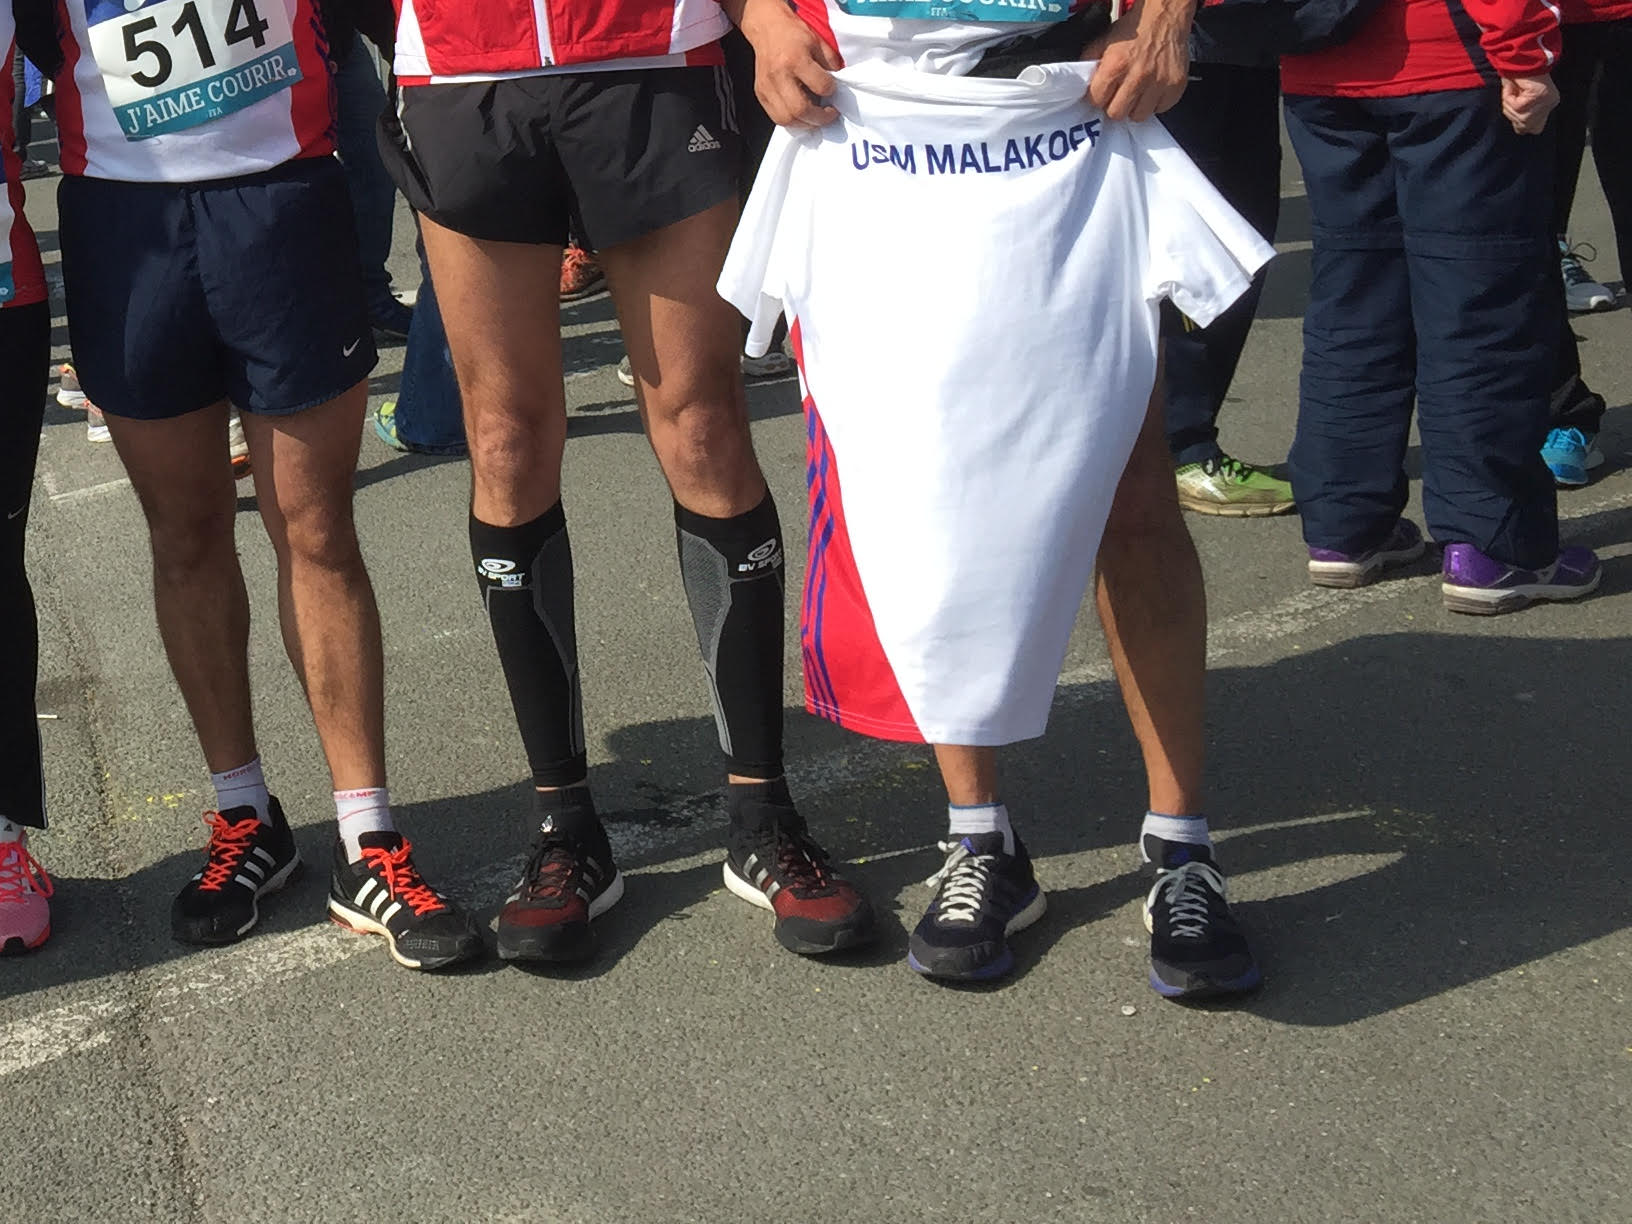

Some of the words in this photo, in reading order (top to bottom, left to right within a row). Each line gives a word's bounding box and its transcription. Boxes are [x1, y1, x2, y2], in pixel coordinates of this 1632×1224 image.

[126, 86, 206, 134] J'AIME
[687, 140, 721, 153] adidas
[850, 138, 918, 175] USM
[924, 118, 1103, 176] MALAKOFF
